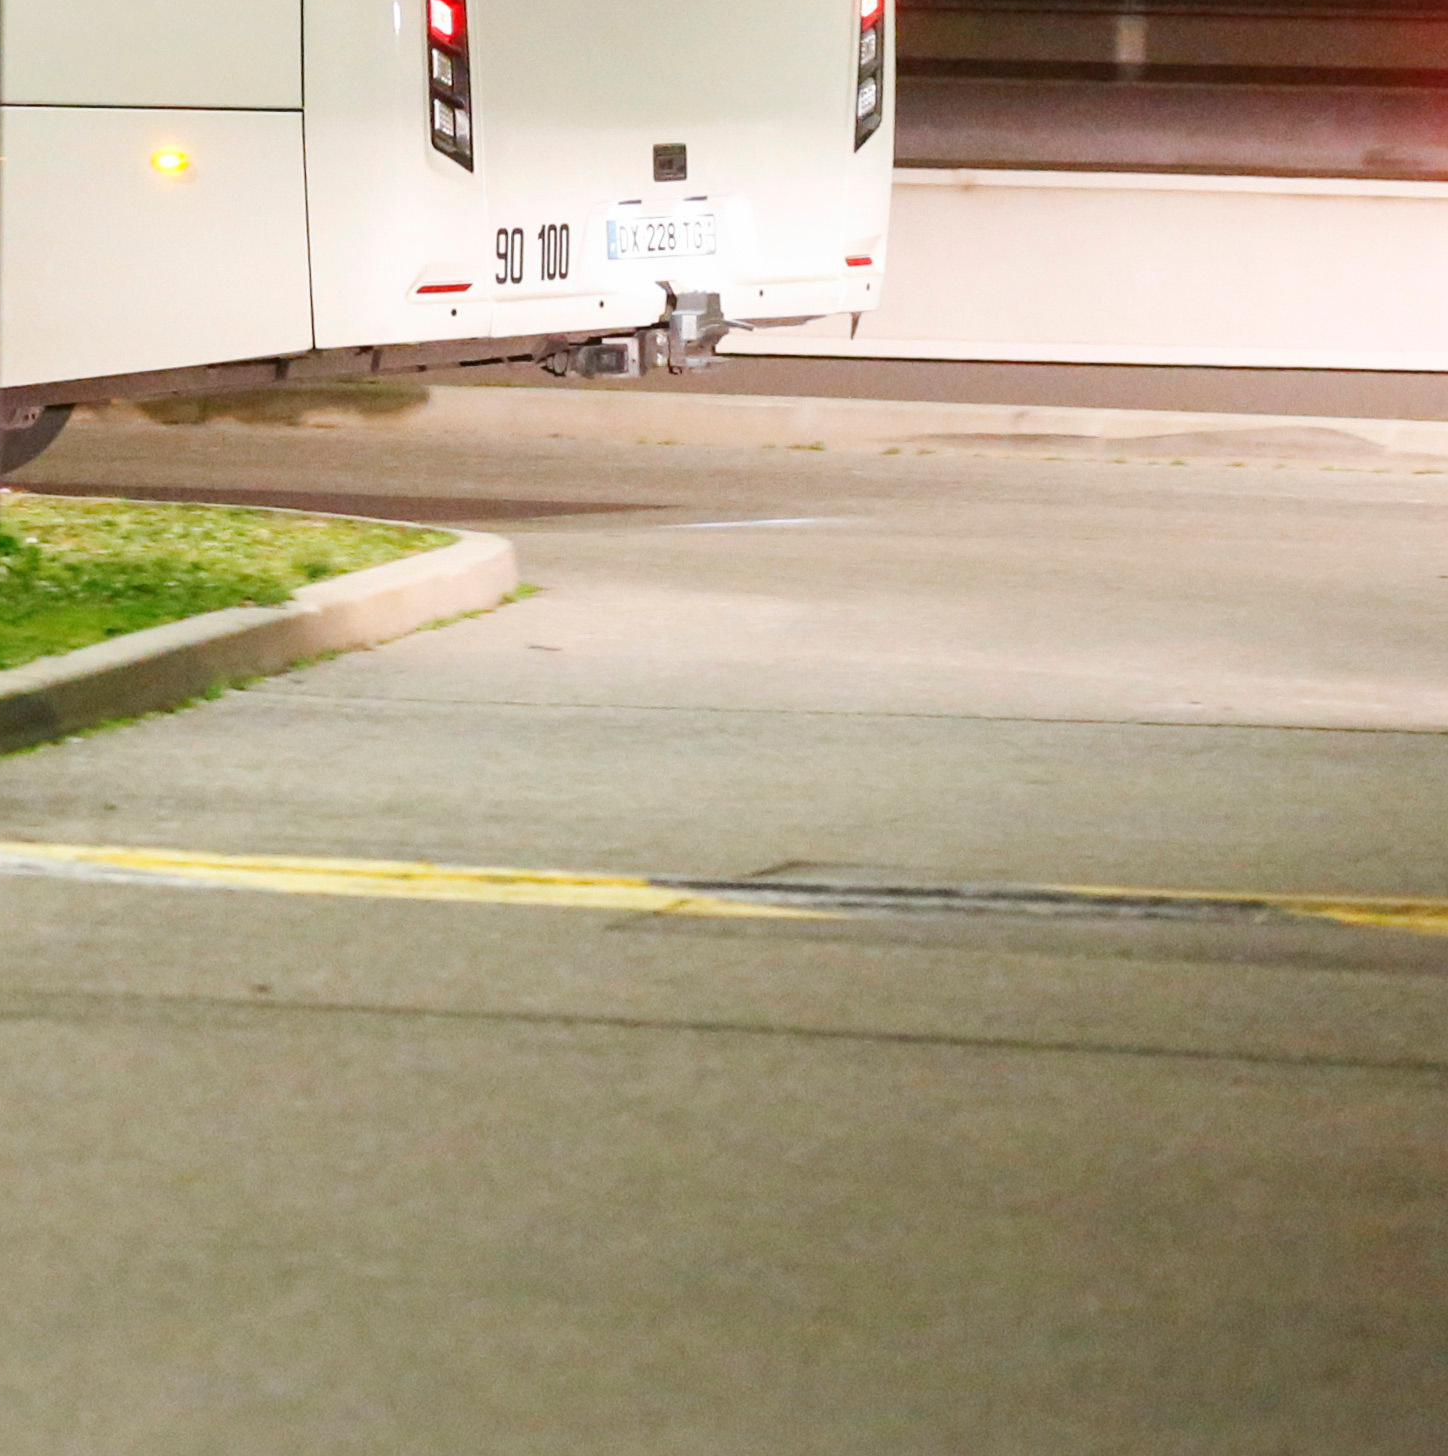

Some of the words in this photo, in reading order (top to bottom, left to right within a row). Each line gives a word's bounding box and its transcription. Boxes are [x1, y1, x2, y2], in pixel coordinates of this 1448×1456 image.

[495, 228, 524, 284] 90
[537, 223, 570, 281] 100
[646, 222, 677, 252] 228
